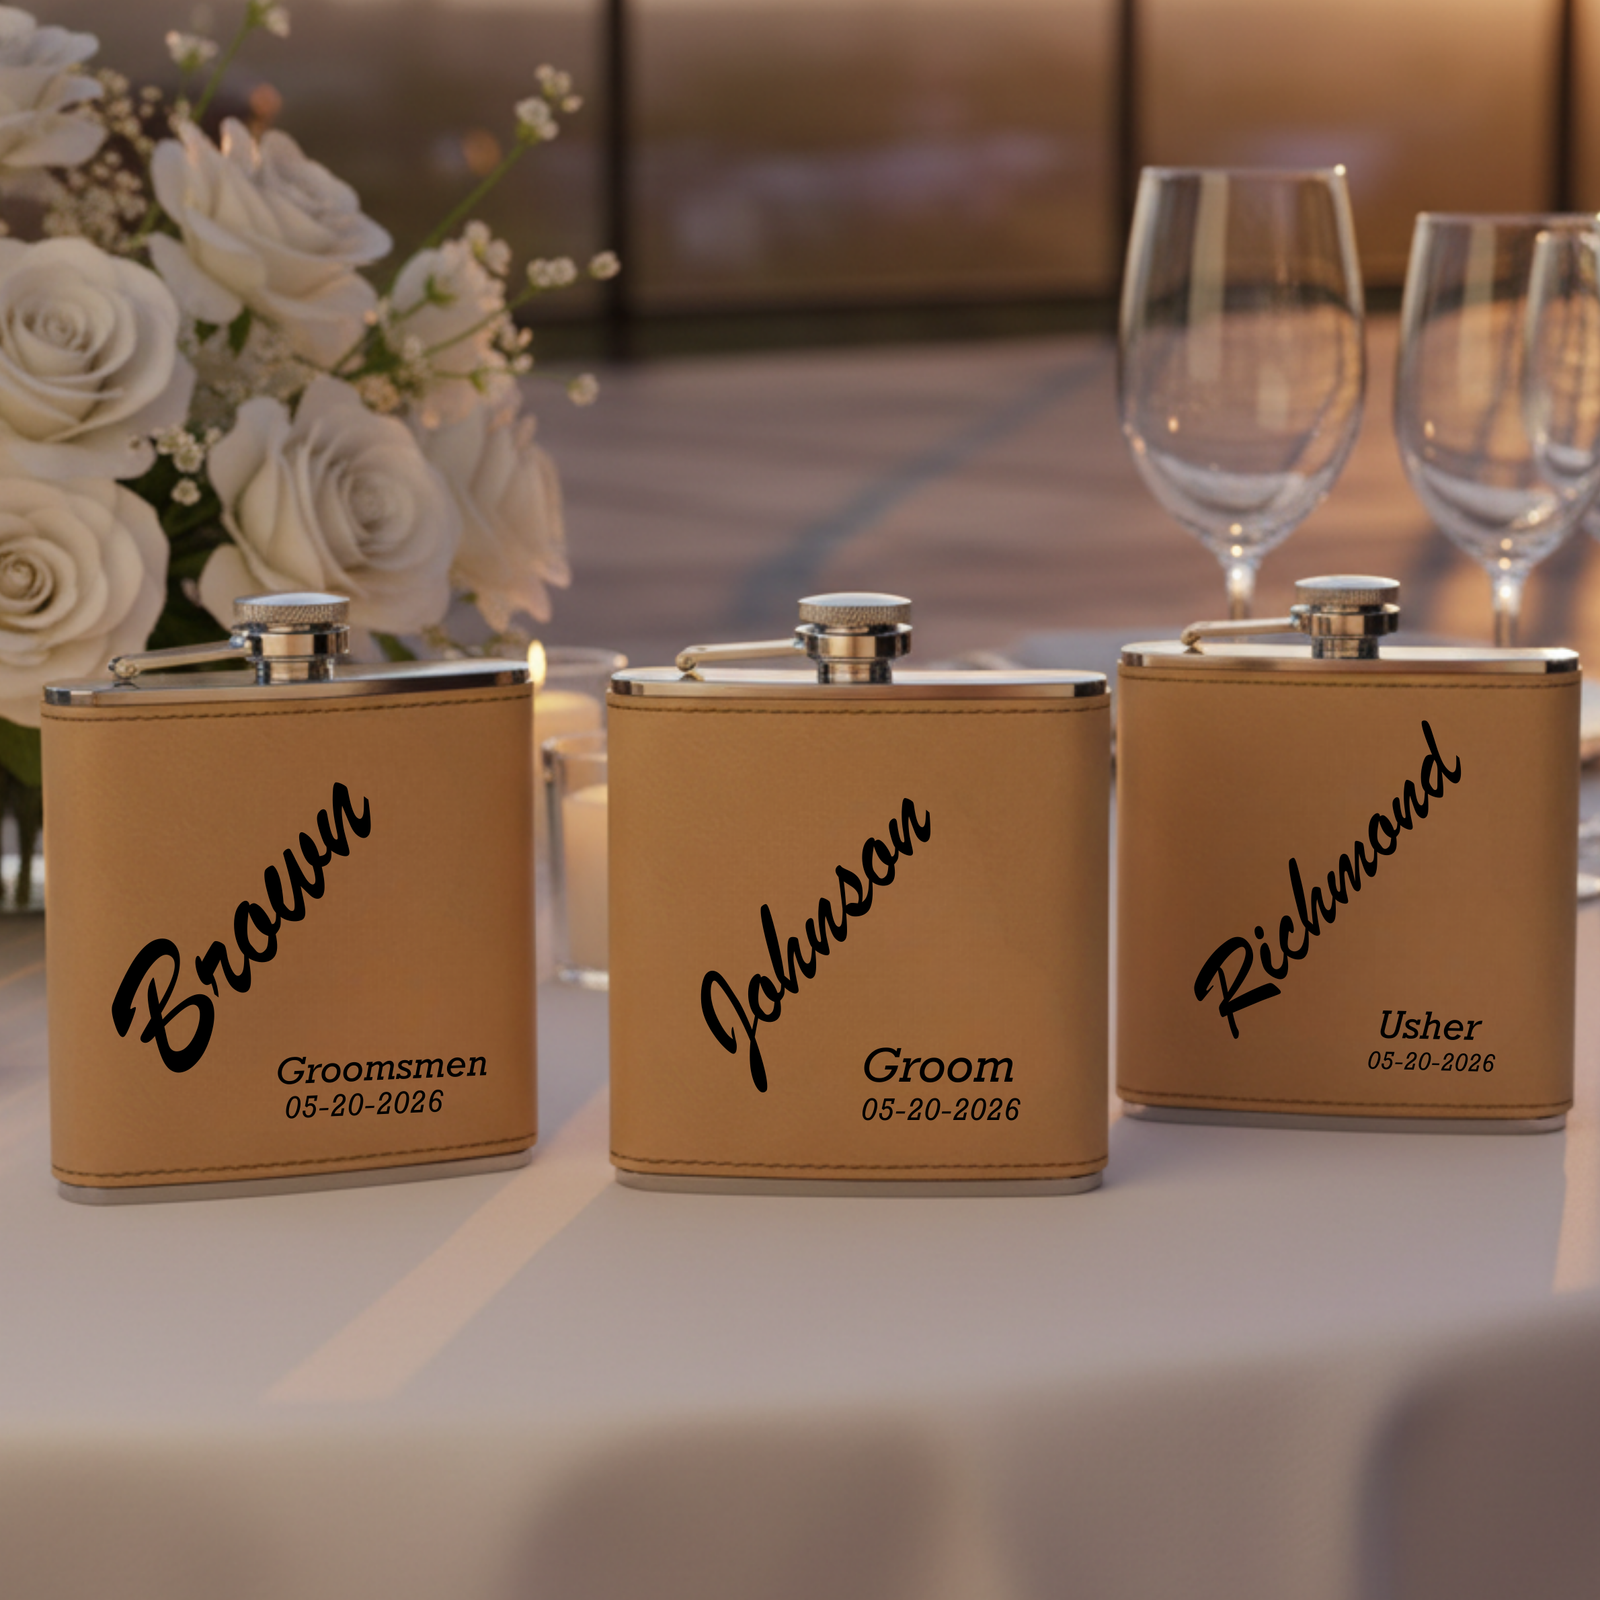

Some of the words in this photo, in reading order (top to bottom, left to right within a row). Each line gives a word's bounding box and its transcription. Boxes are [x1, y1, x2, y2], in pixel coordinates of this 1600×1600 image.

[1193, 719, 1464, 1041] Richmond
[111, 781, 372, 1074] Brown
[700, 797, 932, 1093] Johnson
[1379, 1009, 1483, 1041] Usher
[277, 1056, 488, 1085] Groomsmen
[863, 1046, 1014, 1083] Groom
[1367, 1050, 1496, 1073] 05-20-2026
[285, 1089, 444, 1120] 05-20-2026
[861, 1097, 1021, 1121] 05-20-2026
